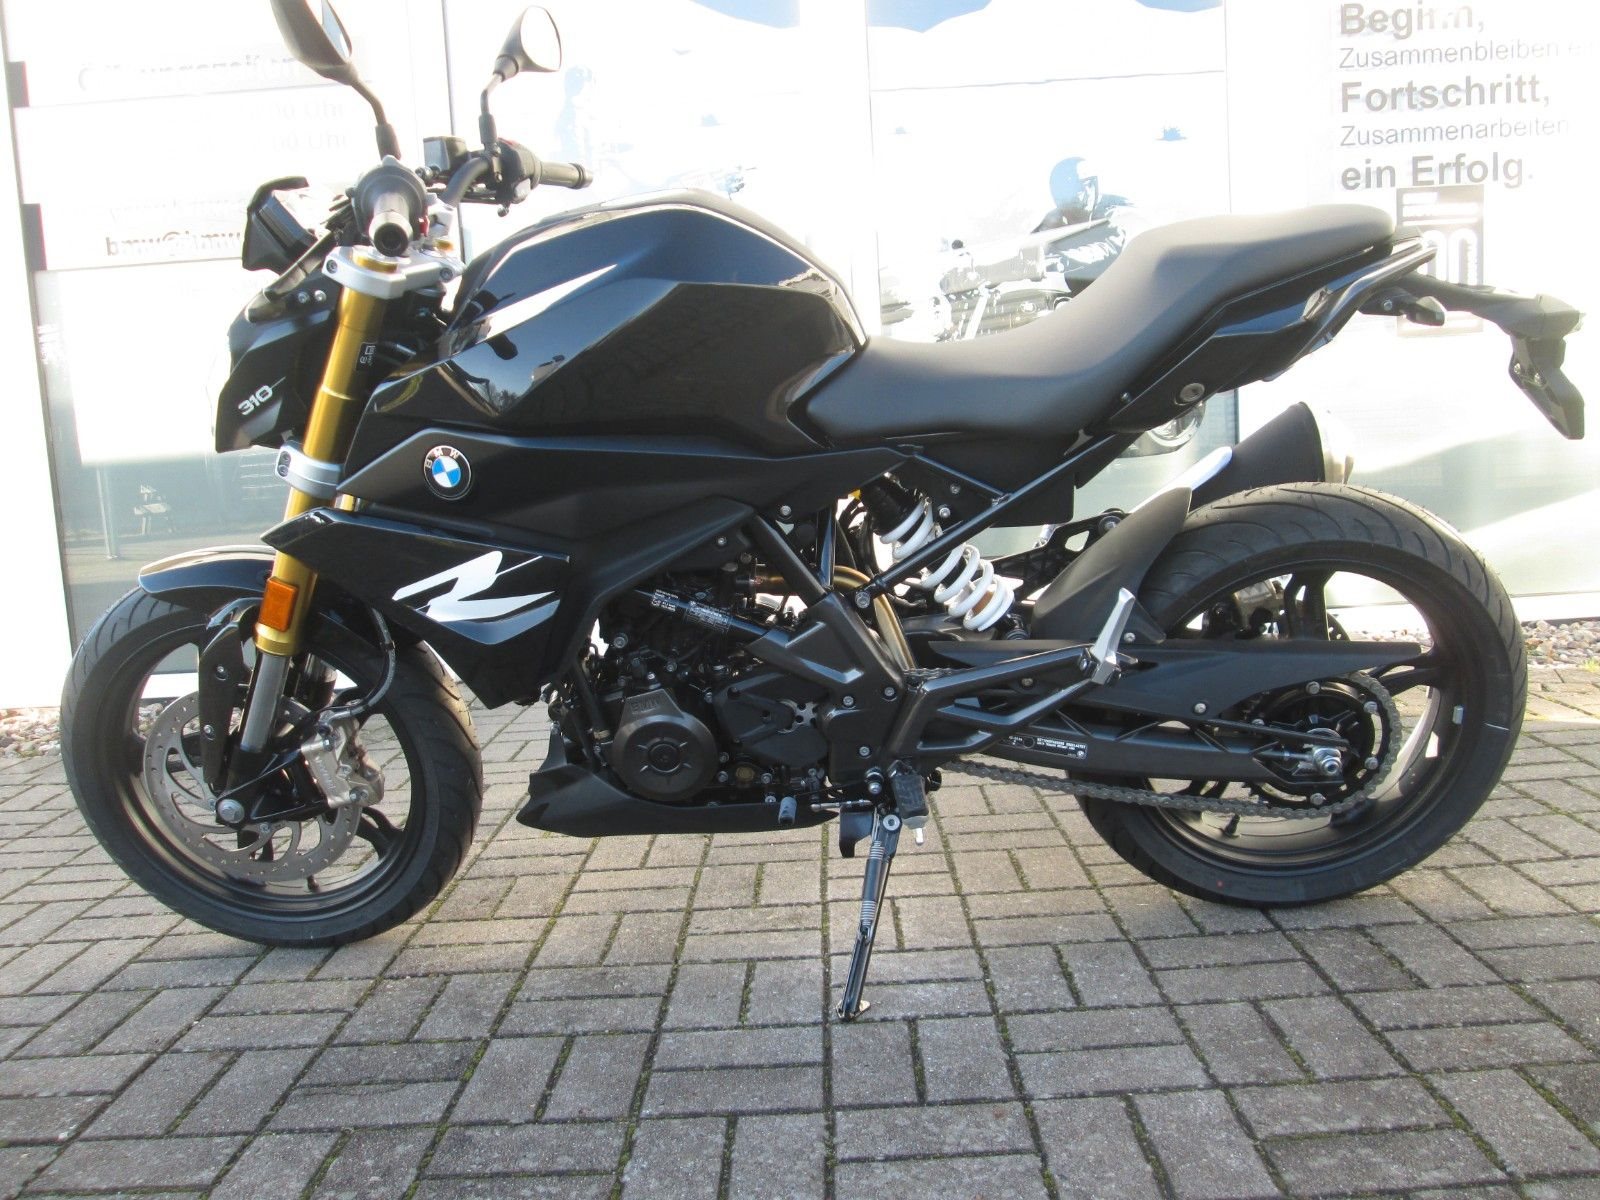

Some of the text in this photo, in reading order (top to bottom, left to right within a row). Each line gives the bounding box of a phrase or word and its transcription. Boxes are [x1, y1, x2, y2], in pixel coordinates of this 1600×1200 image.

[1339, 39, 1559, 68] Zusammenbleiben
[1341, 73, 1550, 112] Fortschritt,
[1340, 117, 1569, 146] Zusammenarbeiten
[1341, 152, 1533, 190] ein Erfolg.
[238, 385, 273, 416] 310
